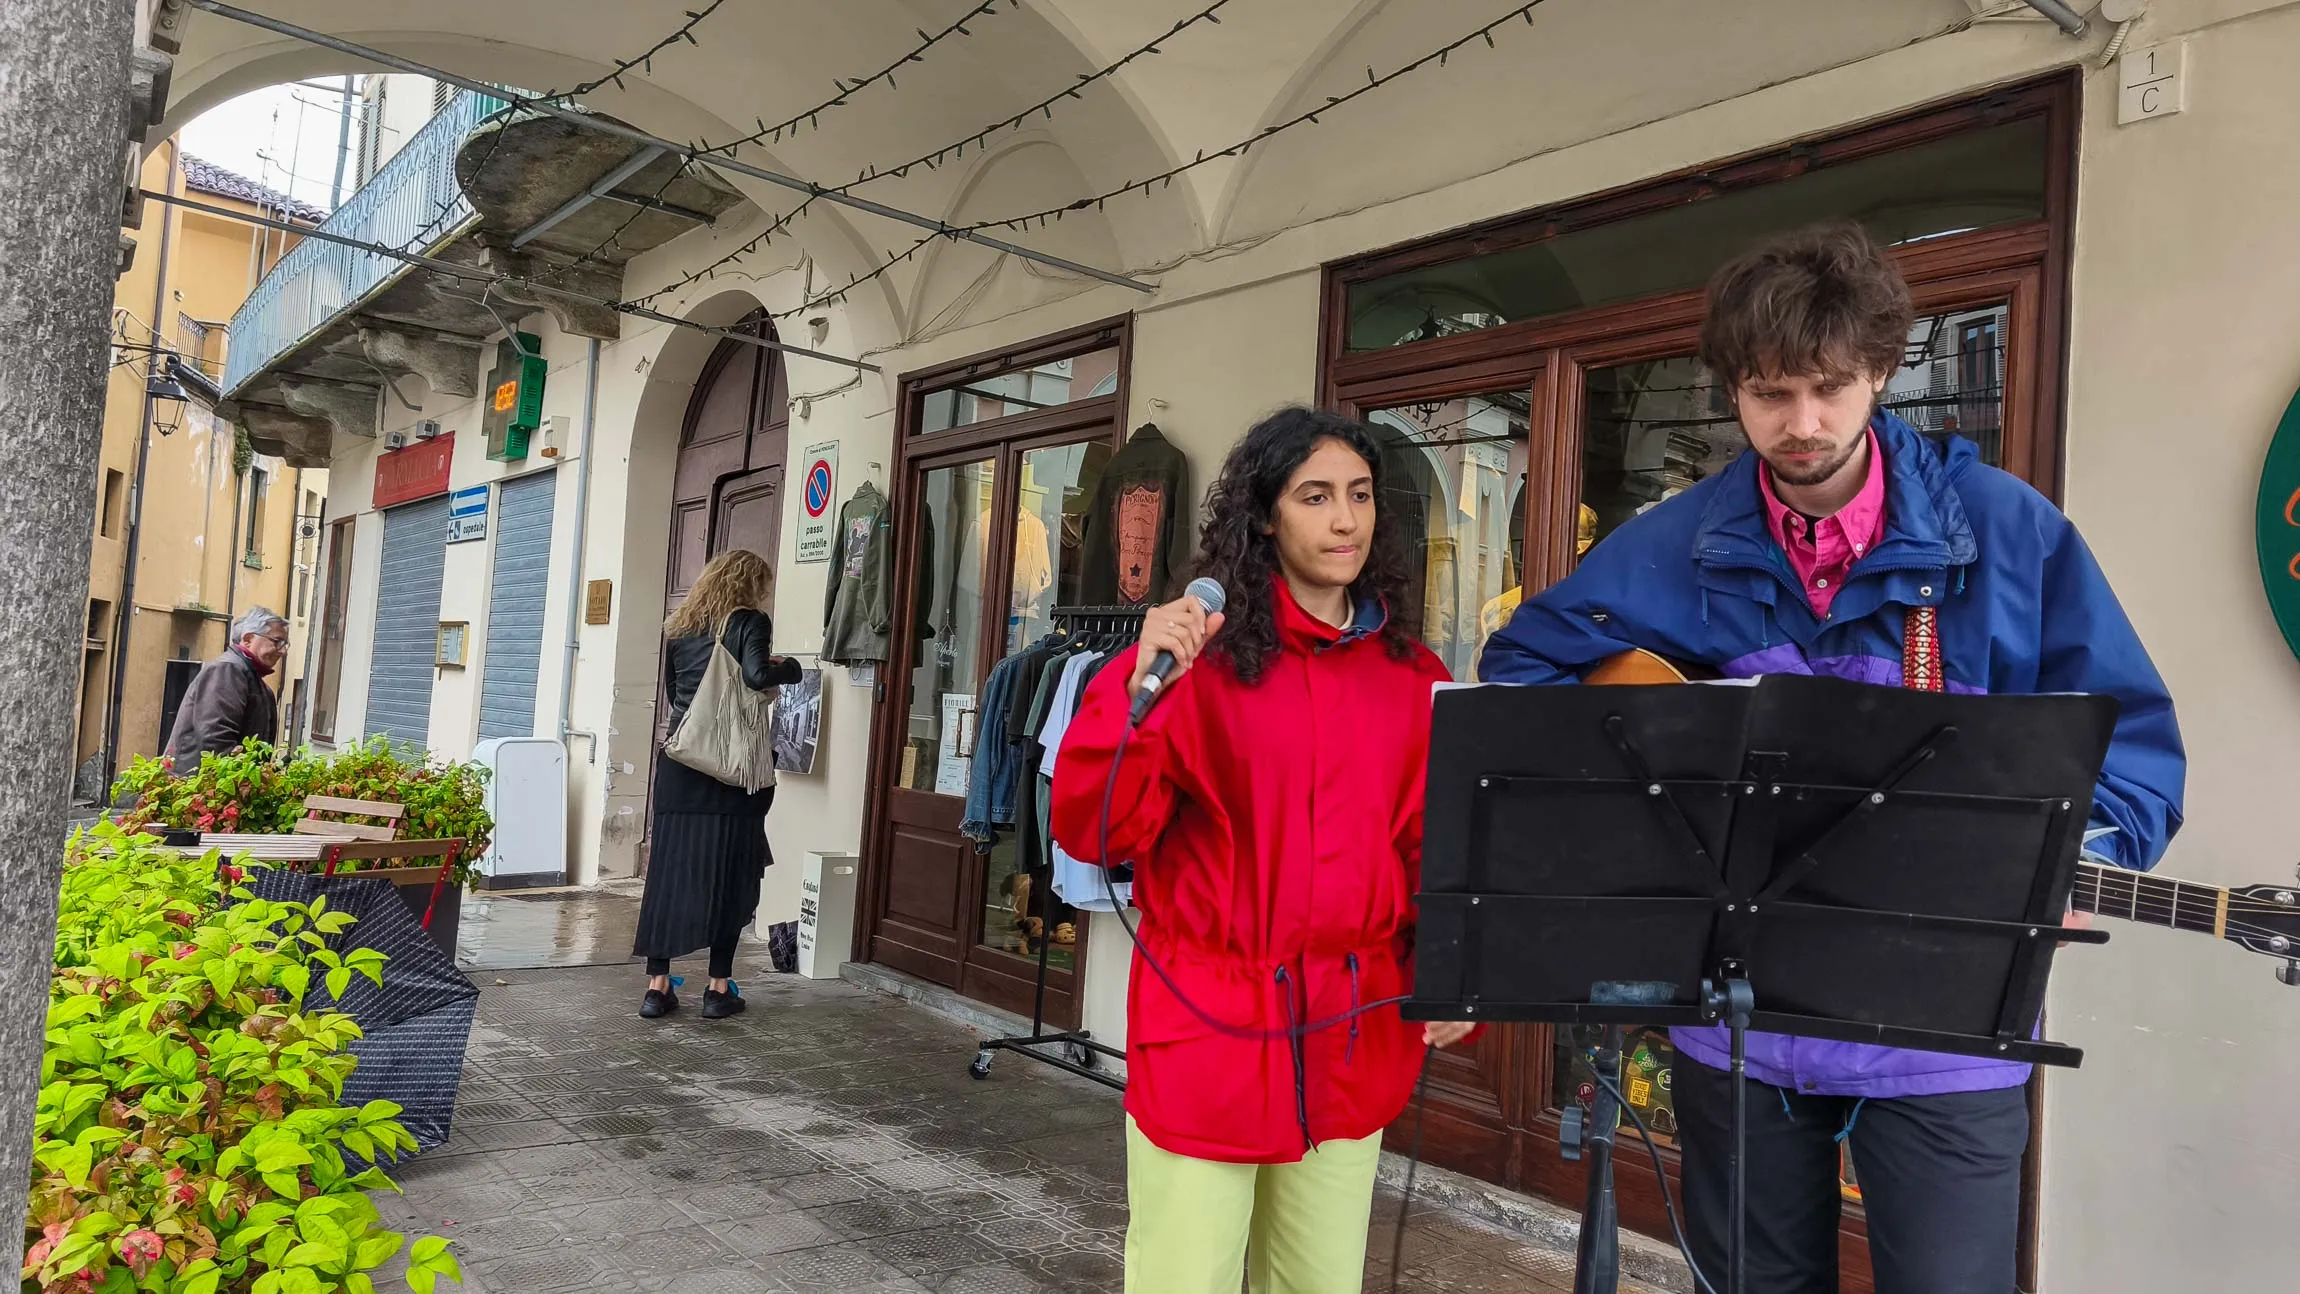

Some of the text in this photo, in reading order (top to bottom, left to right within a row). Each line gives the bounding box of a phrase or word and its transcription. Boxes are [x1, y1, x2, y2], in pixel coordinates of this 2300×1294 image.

[2146, 51, 2156, 75] 1
[2142, 87, 2159, 113] C
[463, 521, 484, 536] ospedale
[806, 525, 824, 536] passo
[800, 538, 828, 550] carrabile
